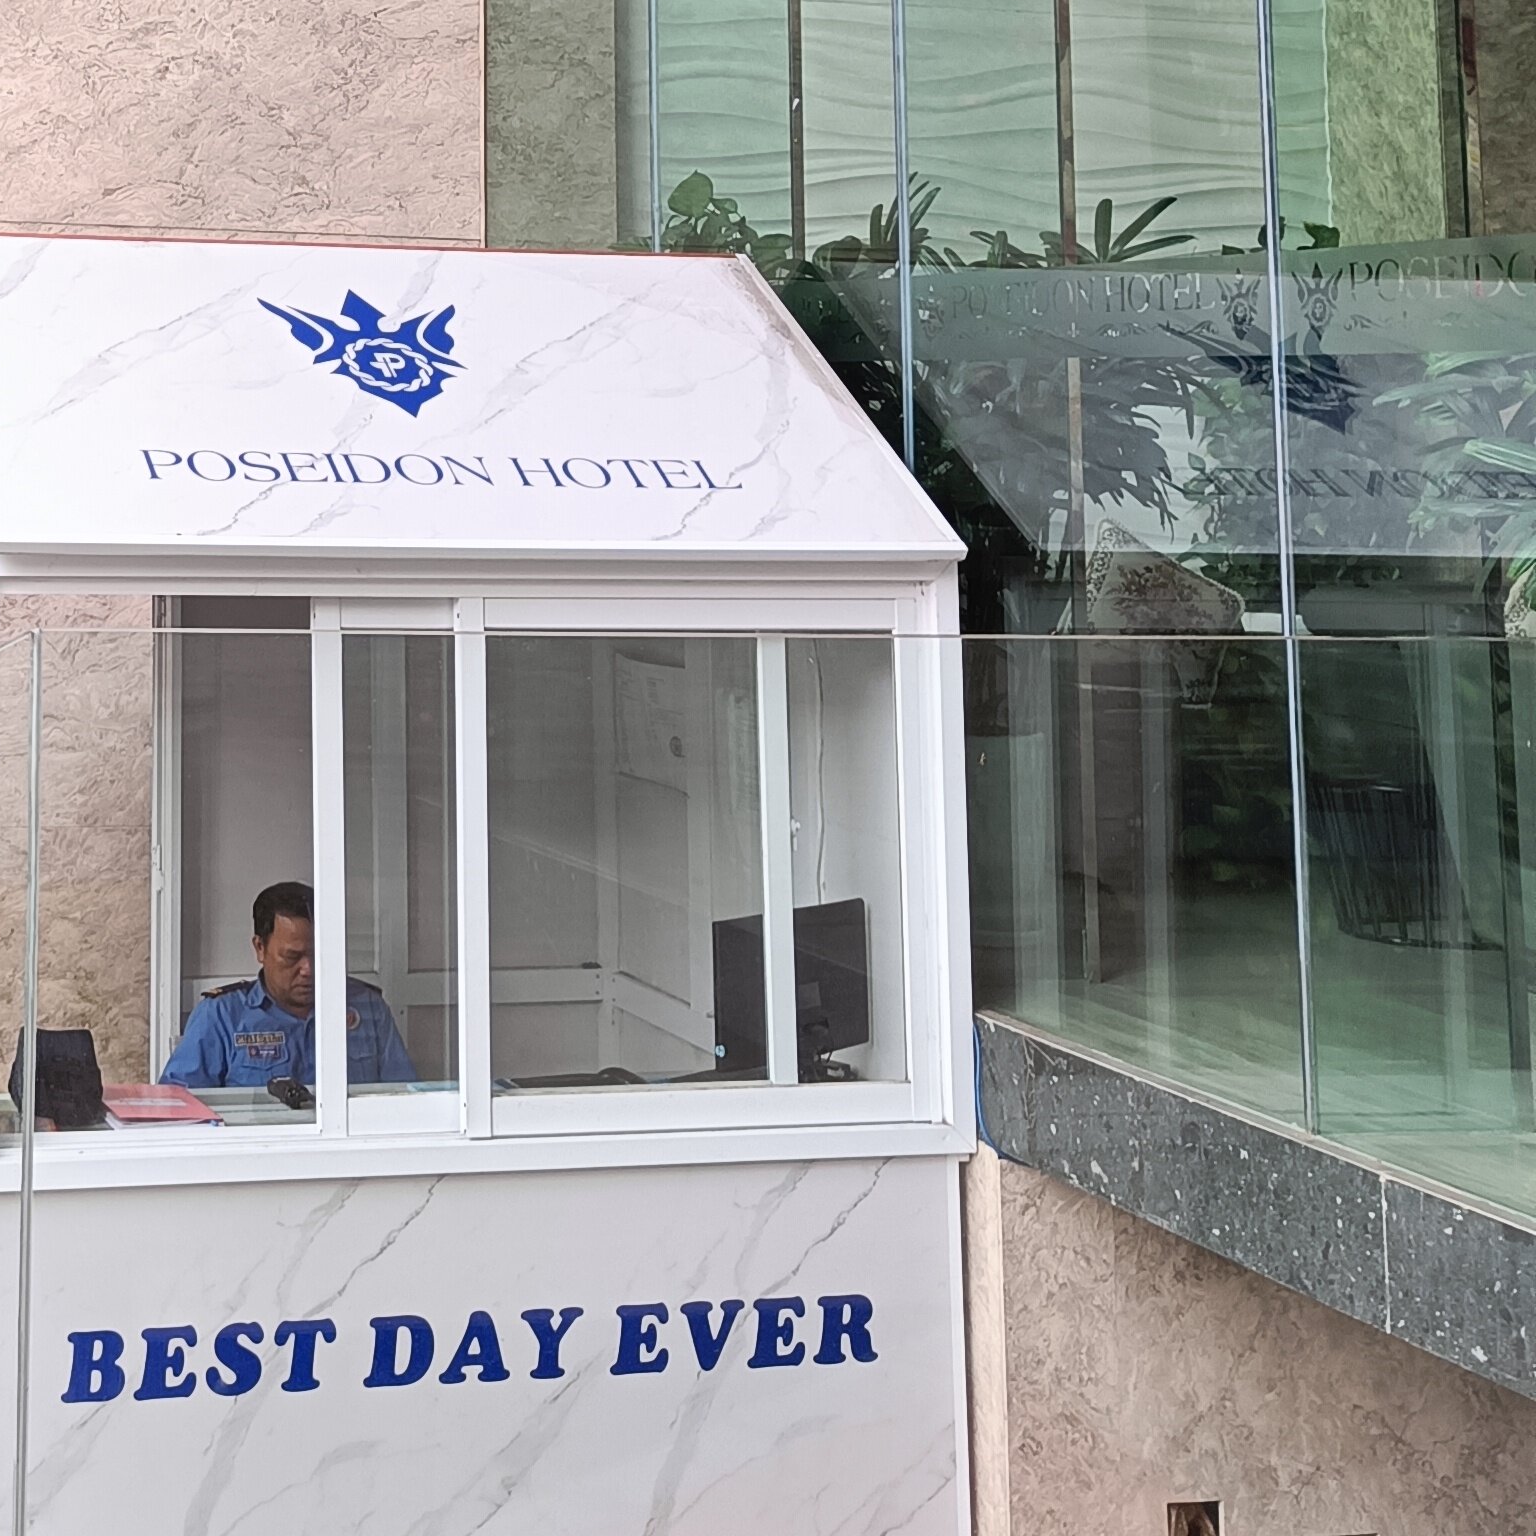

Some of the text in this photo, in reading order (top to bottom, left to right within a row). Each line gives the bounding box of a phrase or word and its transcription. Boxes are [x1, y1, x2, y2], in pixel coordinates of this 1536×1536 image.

[951, 272, 1216, 319] POEIDON HOTEL
[1349, 250, 1536, 302] POSEIDO
[139, 449, 743, 489] POSEIDON HOTEL
[60, 1293, 879, 1403] BEST DAY EVER
